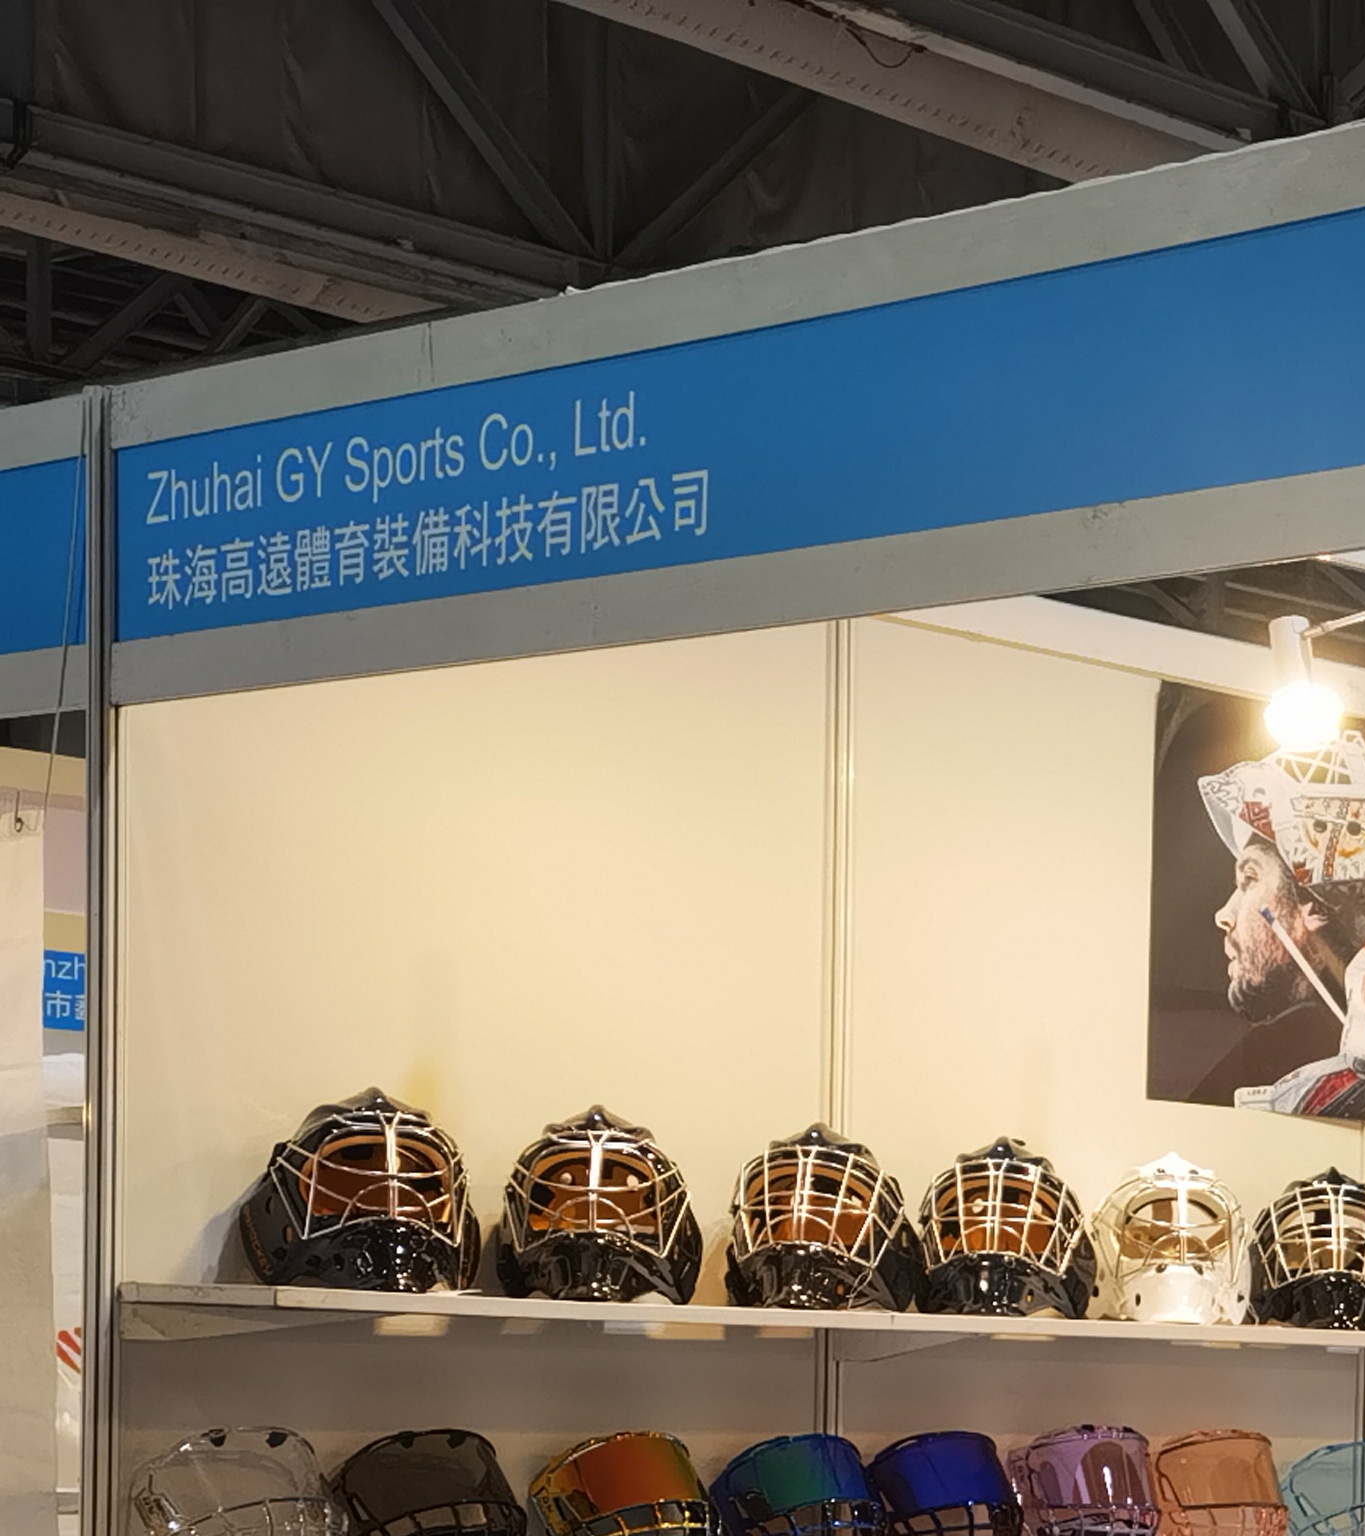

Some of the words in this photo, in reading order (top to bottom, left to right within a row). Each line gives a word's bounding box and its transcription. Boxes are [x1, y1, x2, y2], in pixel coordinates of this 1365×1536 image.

[145, 456, 263, 526] Zhuhai
[275, 442, 334, 503] GY
[345, 427, 465, 503] Sports
[479, 411, 557, 473] Co.,
[573, 391, 648, 457] Ltd.
[146, 470, 711, 612] 珠海高遠體育裝備科技有限公司
